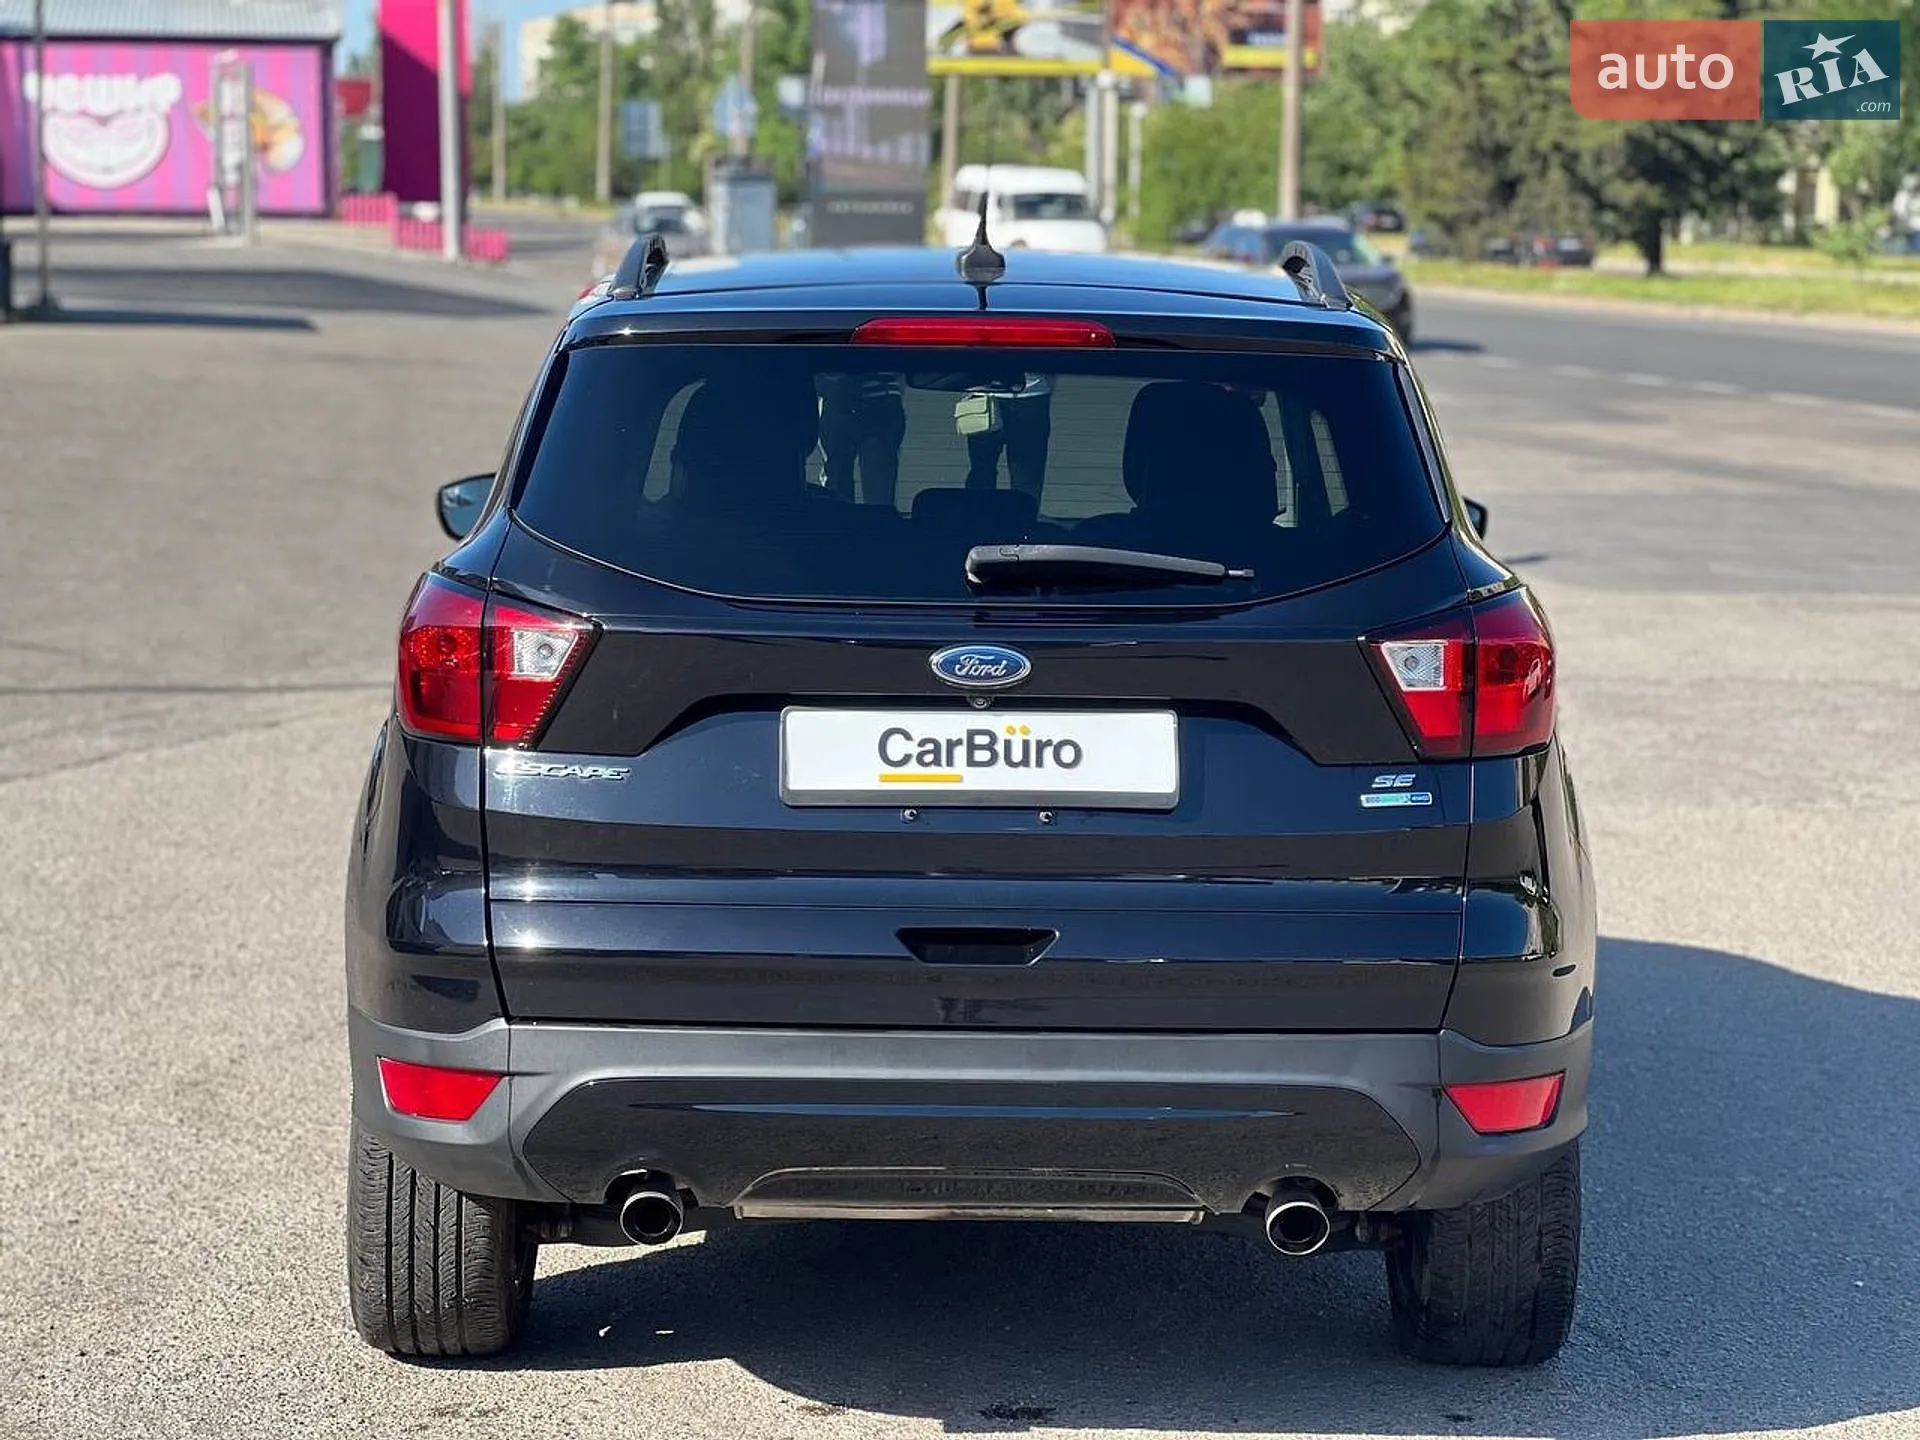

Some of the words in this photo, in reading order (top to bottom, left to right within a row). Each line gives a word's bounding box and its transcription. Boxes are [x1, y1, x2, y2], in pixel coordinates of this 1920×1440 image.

[955, 654, 1008, 677] Ford
[878, 725, 1083, 769] CarBüro
[1371, 774, 1416, 788] SE
